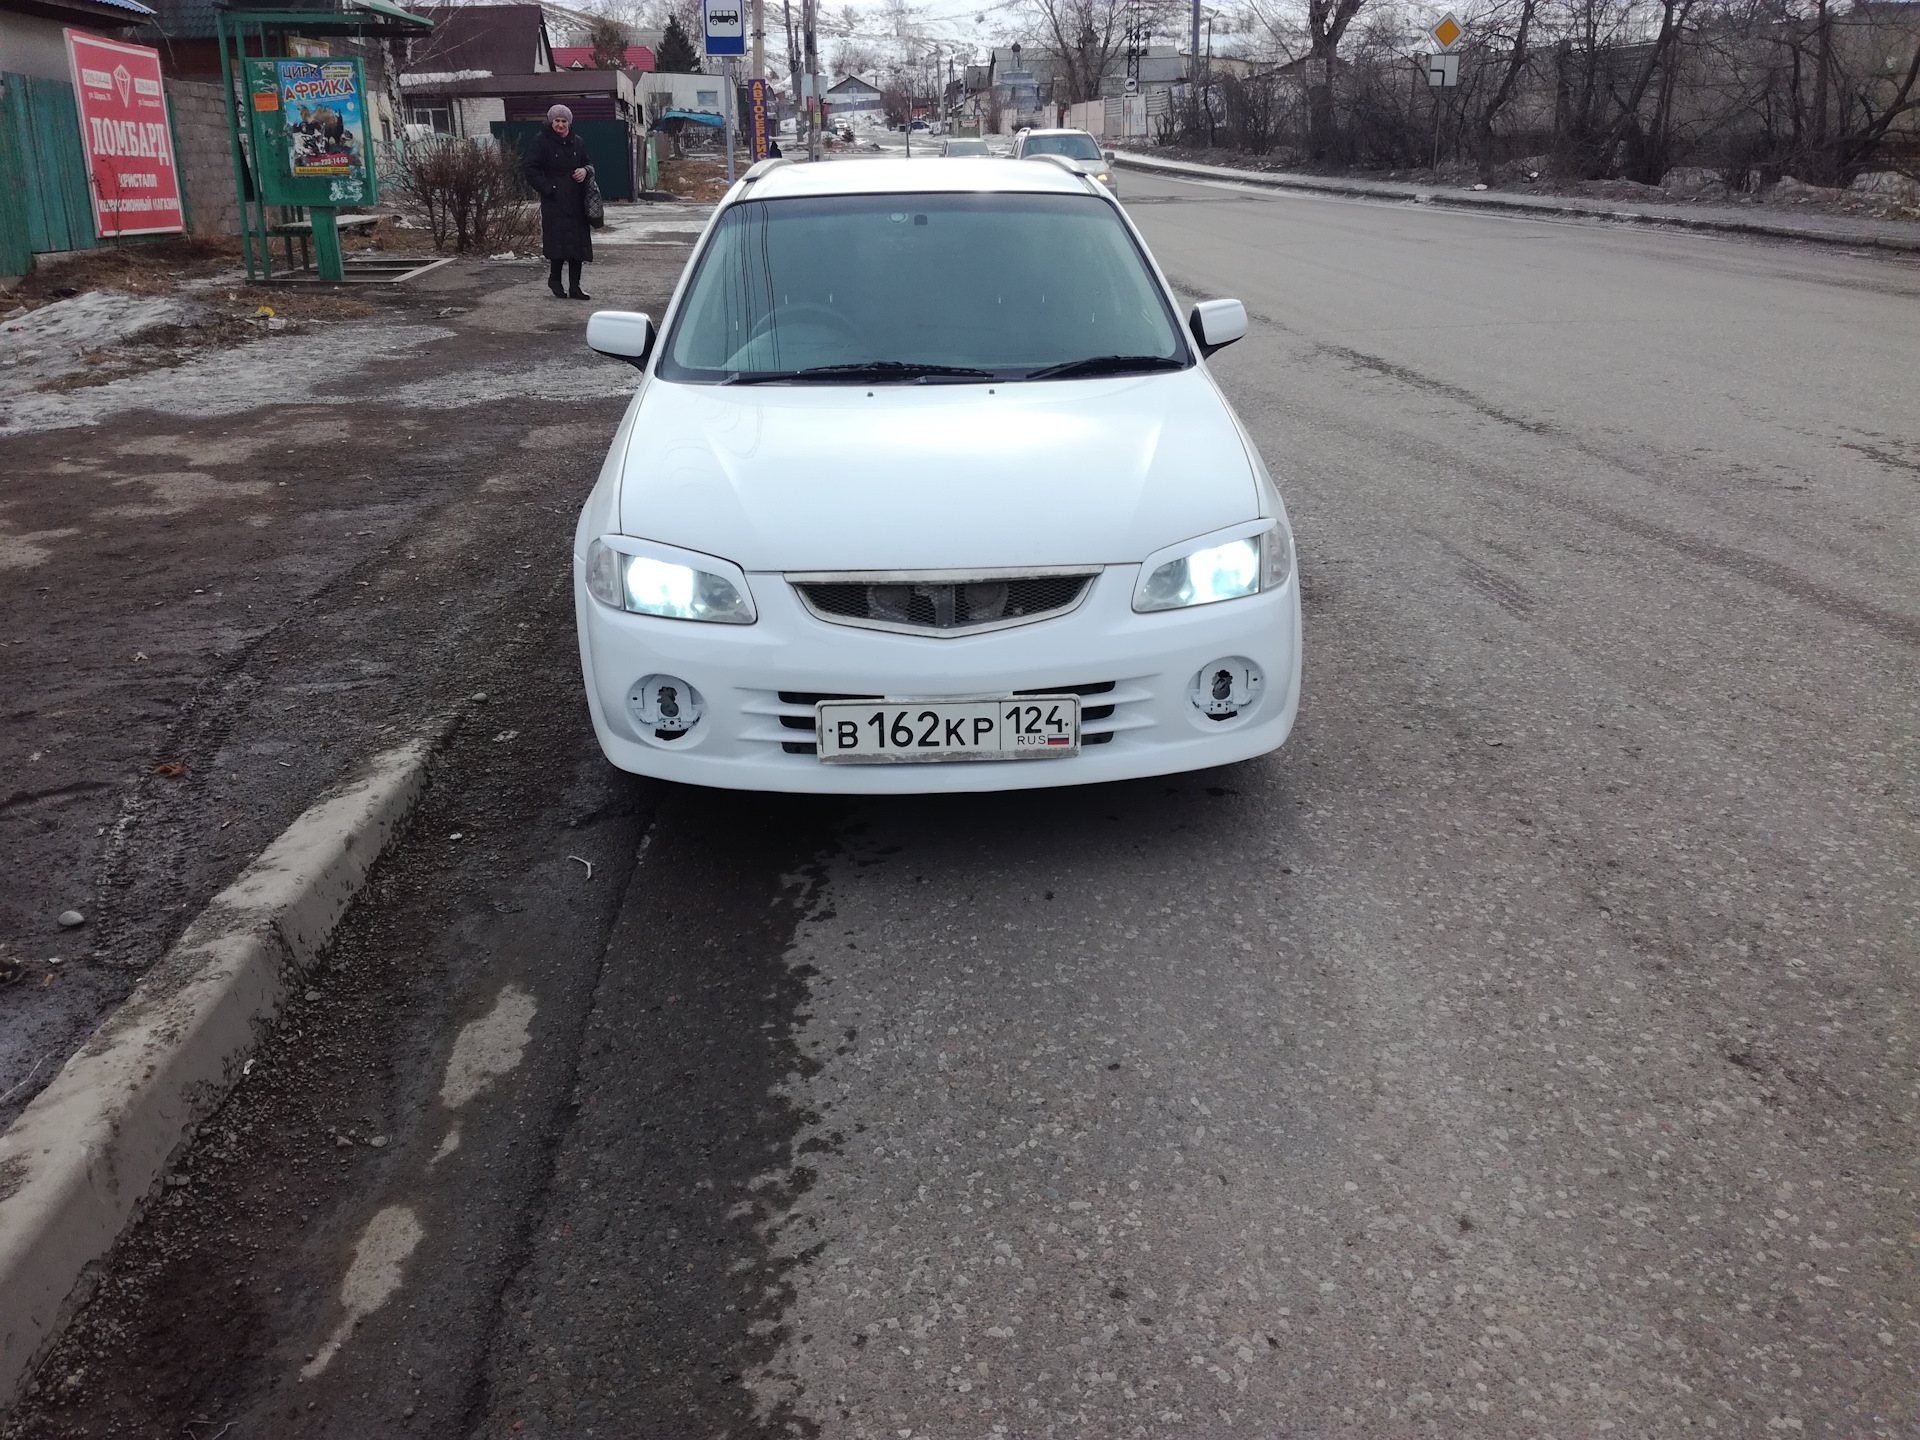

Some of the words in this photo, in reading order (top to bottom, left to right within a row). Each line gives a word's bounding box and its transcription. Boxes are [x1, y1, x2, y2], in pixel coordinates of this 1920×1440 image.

[282, 65, 319, 79] ЦИРК
[285, 78, 354, 101] АФРИКА
[752, 81, 768, 161] АВТОСЕРВИС
[90, 117, 170, 166] ЛОМБАРД
[1005, 705, 1063, 734] 124
[1017, 735, 1046, 746] RUS
